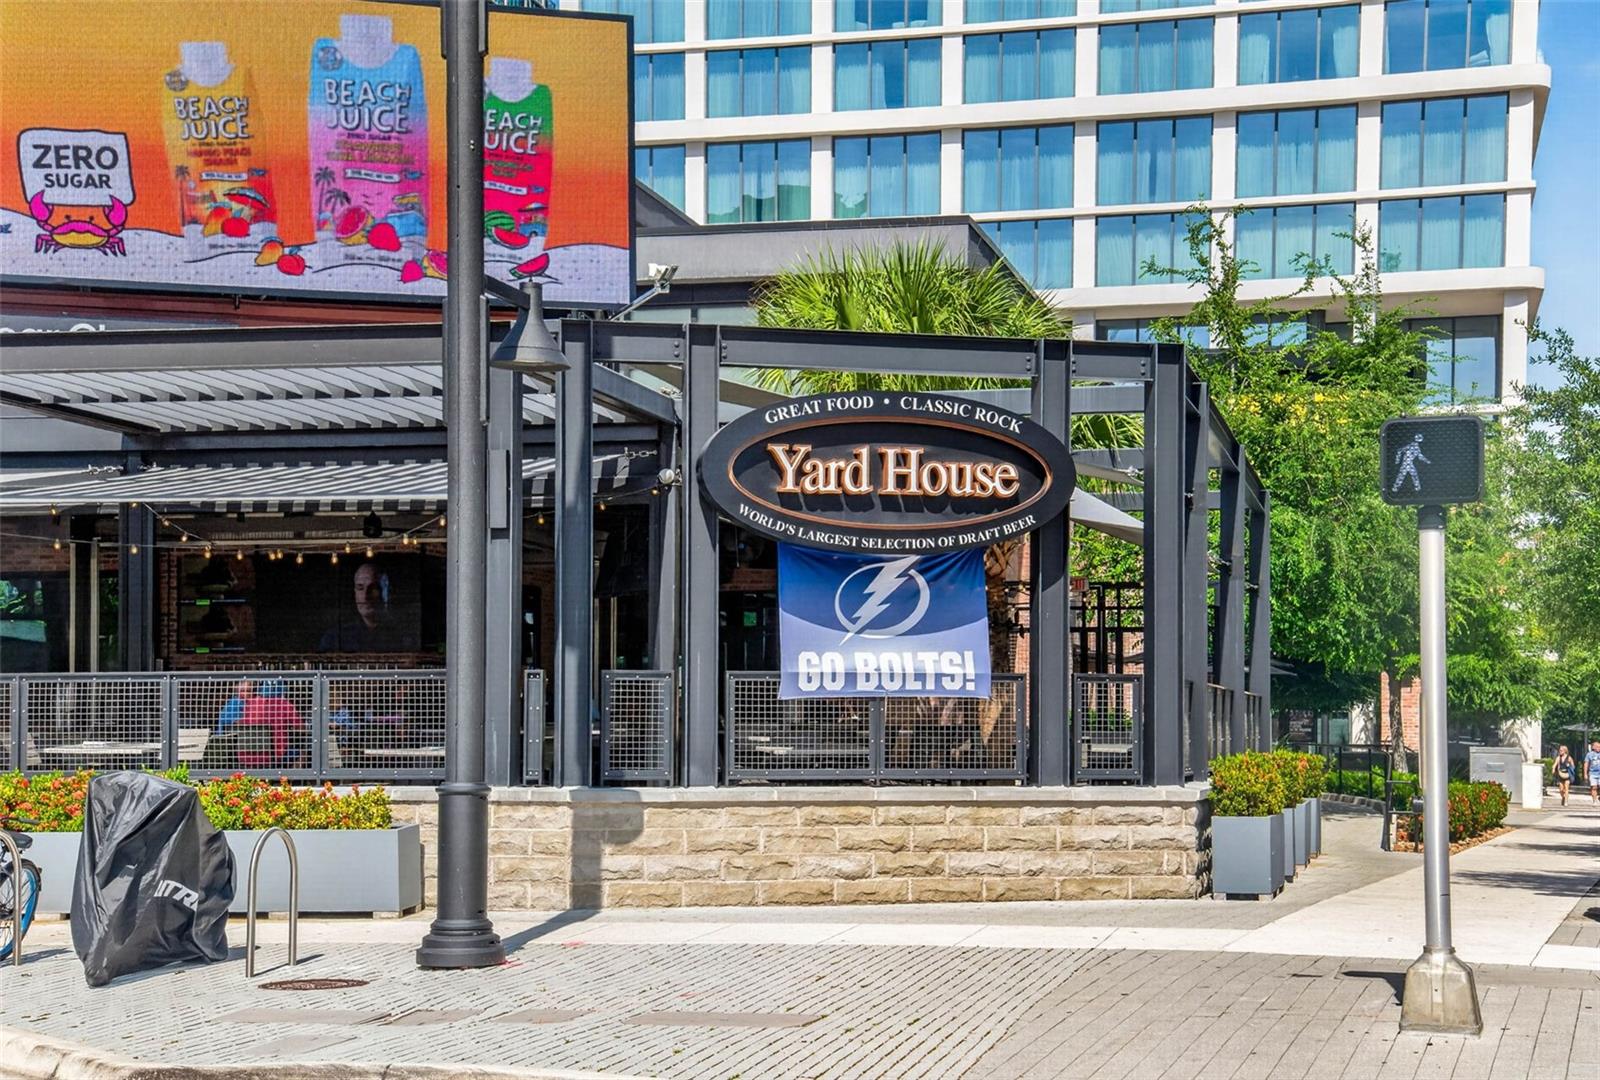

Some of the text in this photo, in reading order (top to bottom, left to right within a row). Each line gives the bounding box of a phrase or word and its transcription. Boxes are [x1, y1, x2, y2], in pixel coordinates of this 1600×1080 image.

[325, 78, 412, 107] BEACH
[173, 95, 249, 121] BEACH
[326, 101, 410, 134] JUICE
[484, 108, 542, 131] EACH
[181, 111, 250, 140] JUICE
[32, 144, 119, 170] ZERO
[483, 130, 540, 155] UICE
[44, 173, 112, 189] SUGAR
[764, 395, 1024, 434] GREAT FOOD CLASSIC ROCK
[767, 443, 1021, 498] Yard House
[739, 503, 1036, 550] WORLD'S LARGEST SELECTION OF DRAFT BEER
[798, 650, 976, 692] GO BOLTS!
